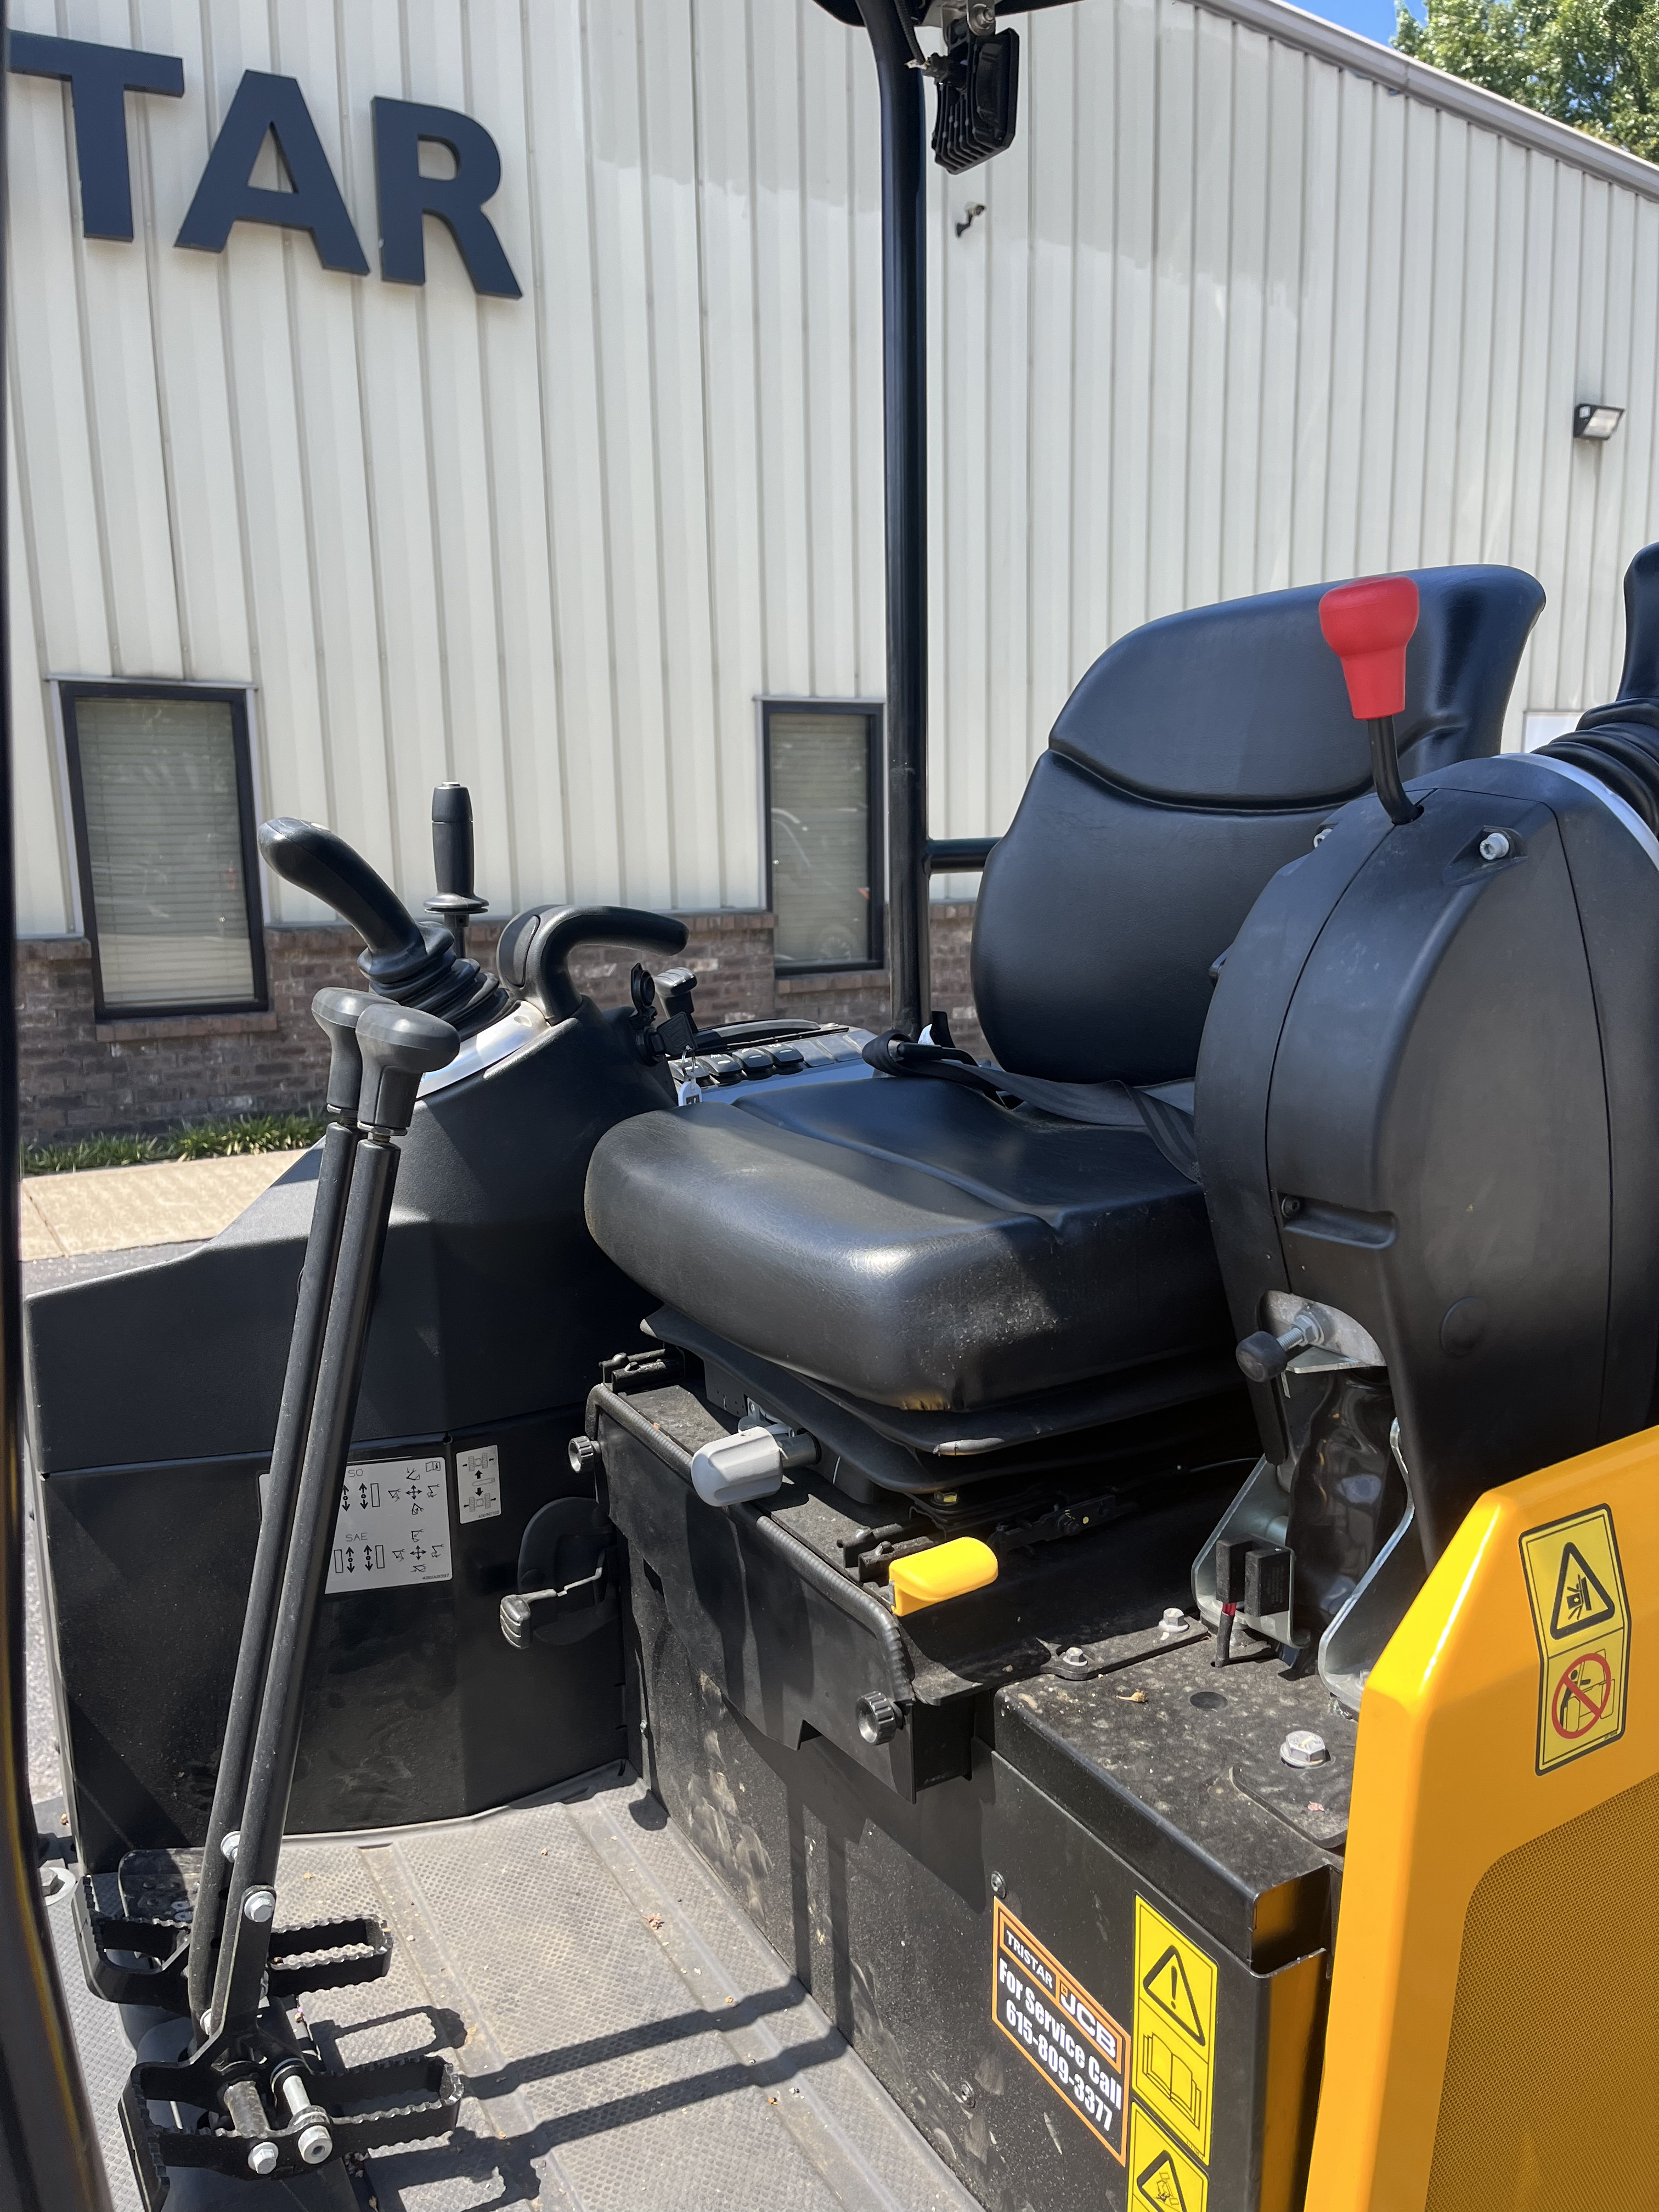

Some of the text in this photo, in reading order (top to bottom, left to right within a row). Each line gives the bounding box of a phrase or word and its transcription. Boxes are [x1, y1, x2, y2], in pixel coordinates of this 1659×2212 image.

[8, 29, 523, 300] TAR
[346, 1532, 368, 1542] SAE
[348, 1468, 363, 1477] SO
[999, 1957, 1122, 2111] For Service Call
[1006, 1929, 1116, 2058] TRISTAR JCB
[1006, 1999, 1113, 2131] 615-809-3377
